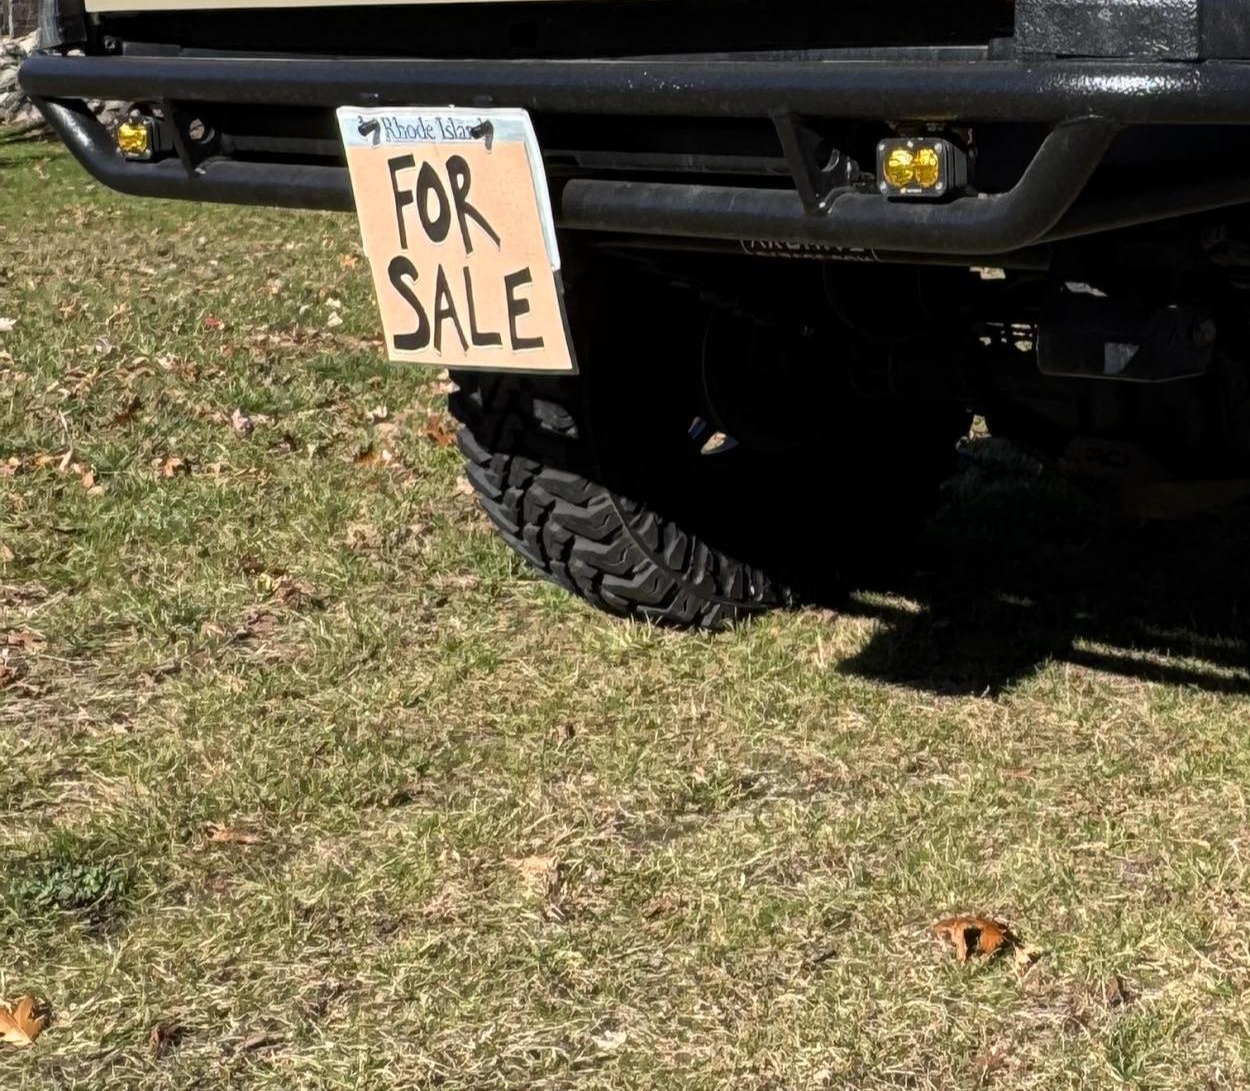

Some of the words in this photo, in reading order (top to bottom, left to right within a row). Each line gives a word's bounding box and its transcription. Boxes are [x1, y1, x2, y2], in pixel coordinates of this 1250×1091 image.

[381, 115, 436, 142] Rhode
[387, 153, 501, 255] FOR
[387, 255, 545, 355] SALE
